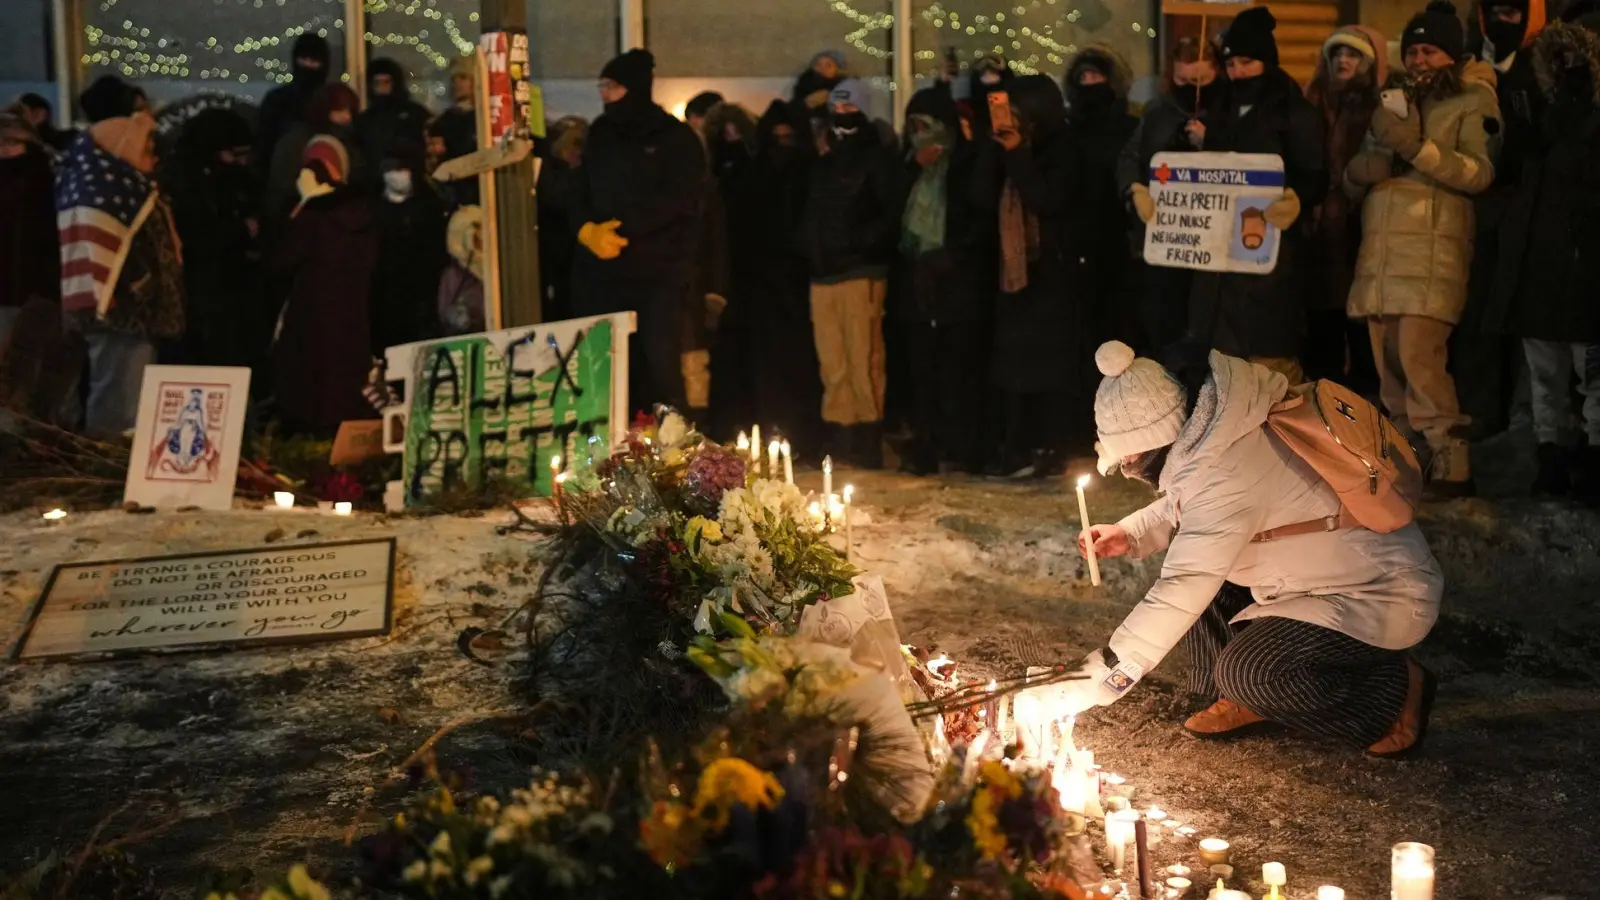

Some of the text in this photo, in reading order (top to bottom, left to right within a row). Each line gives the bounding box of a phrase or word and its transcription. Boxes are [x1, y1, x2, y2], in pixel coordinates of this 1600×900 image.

[1175, 168, 1249, 185] VA HOSPITAL
[1156, 190, 1230, 212] ALEX PRETTI
[1156, 211, 1213, 230] ICU NURSE
[1150, 231, 1202, 247] NEIGHBOR
[1166, 247, 1212, 265] FRIEND
[428, 329, 585, 411] ALEX
[77, 570, 101, 580] BE
[109, 563, 189, 578] STRONG
[206, 551, 337, 569] COURAGEOUS
[113, 565, 295, 588] DO NOT BE AFRAID
[195, 568, 368, 591] OR DISCOURAGED
[70, 583, 329, 611] FOR THE LORD YOUR GOD
[161, 591, 348, 615] WILL BE WITH YOU
[89, 607, 371, 639] wherever you go
